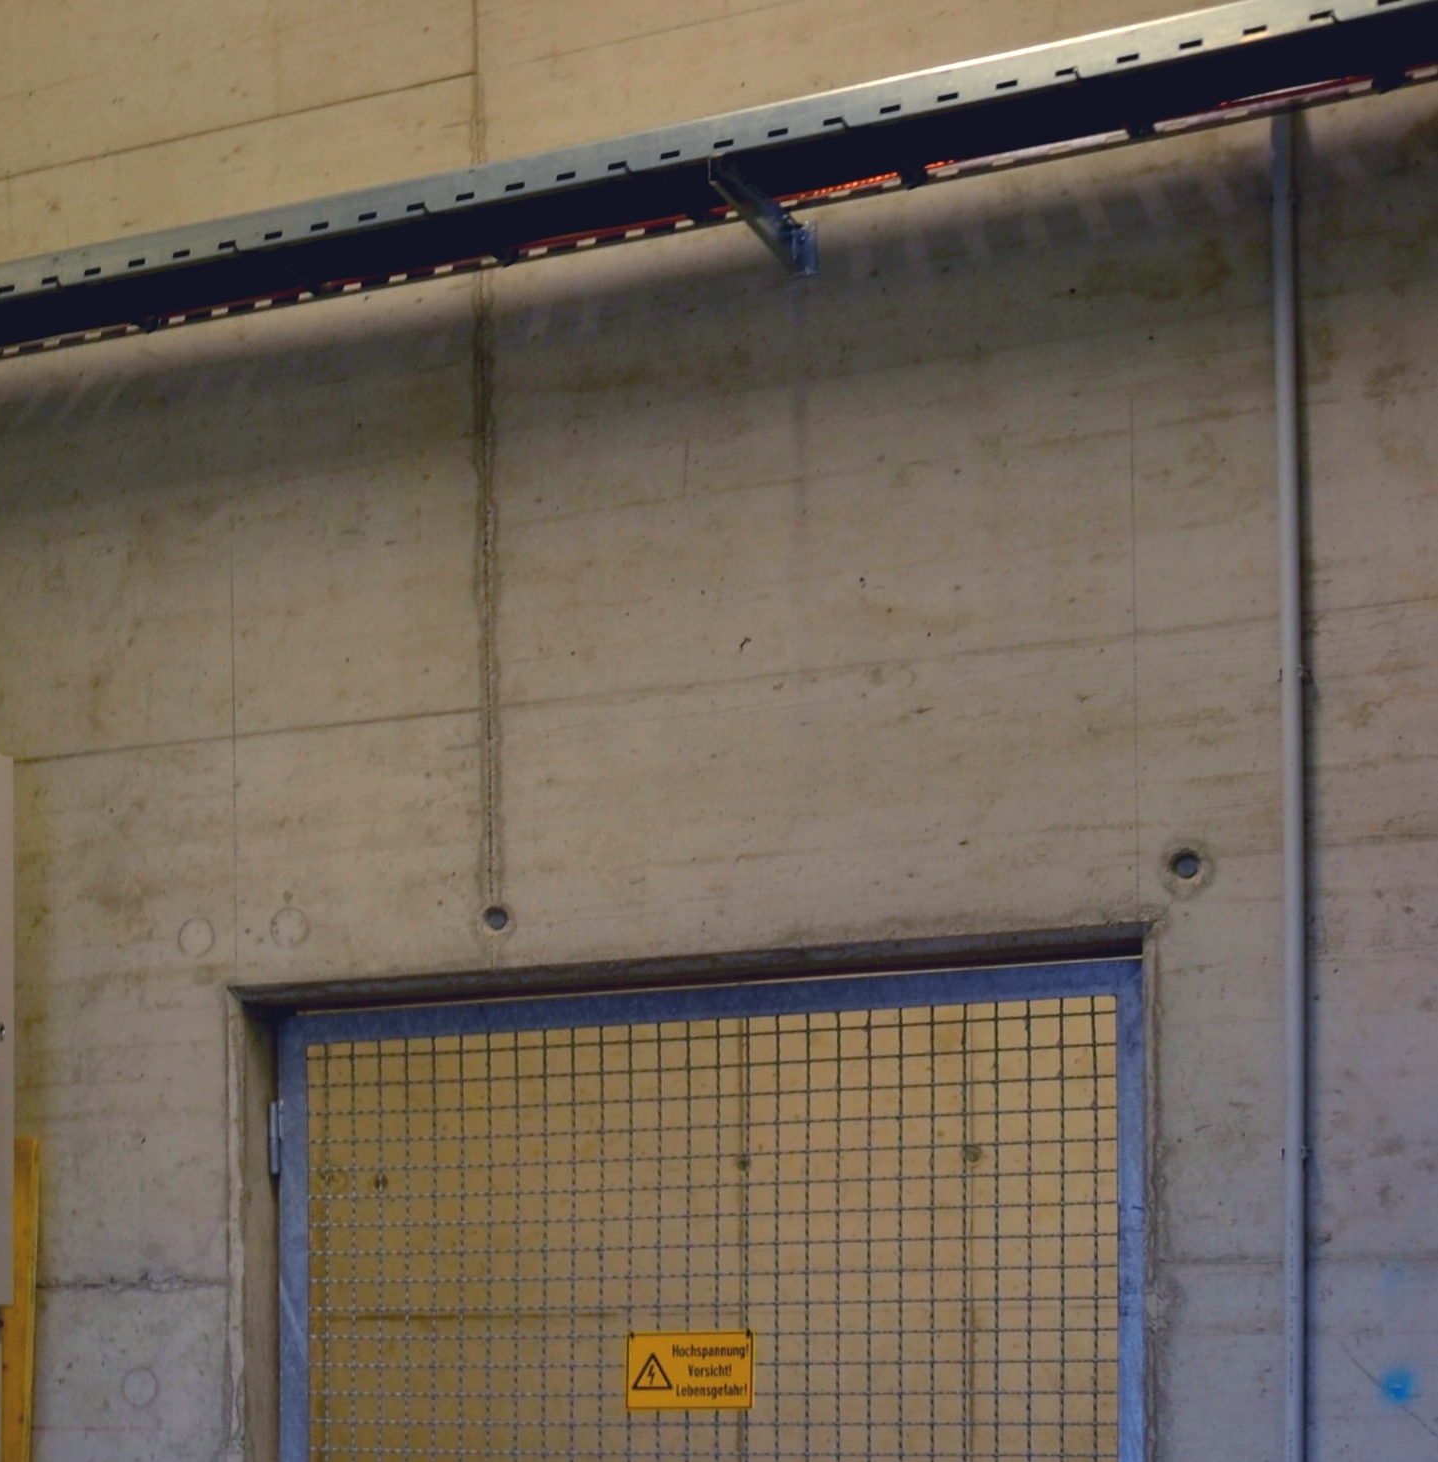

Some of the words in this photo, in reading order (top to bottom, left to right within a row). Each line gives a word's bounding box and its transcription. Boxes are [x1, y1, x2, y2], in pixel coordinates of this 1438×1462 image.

[672, 1343, 749, 1359] Hochspannung!
[688, 1363, 732, 1378] Vorsicht!
[675, 1383, 748, 1399] Lebensgefahr!
